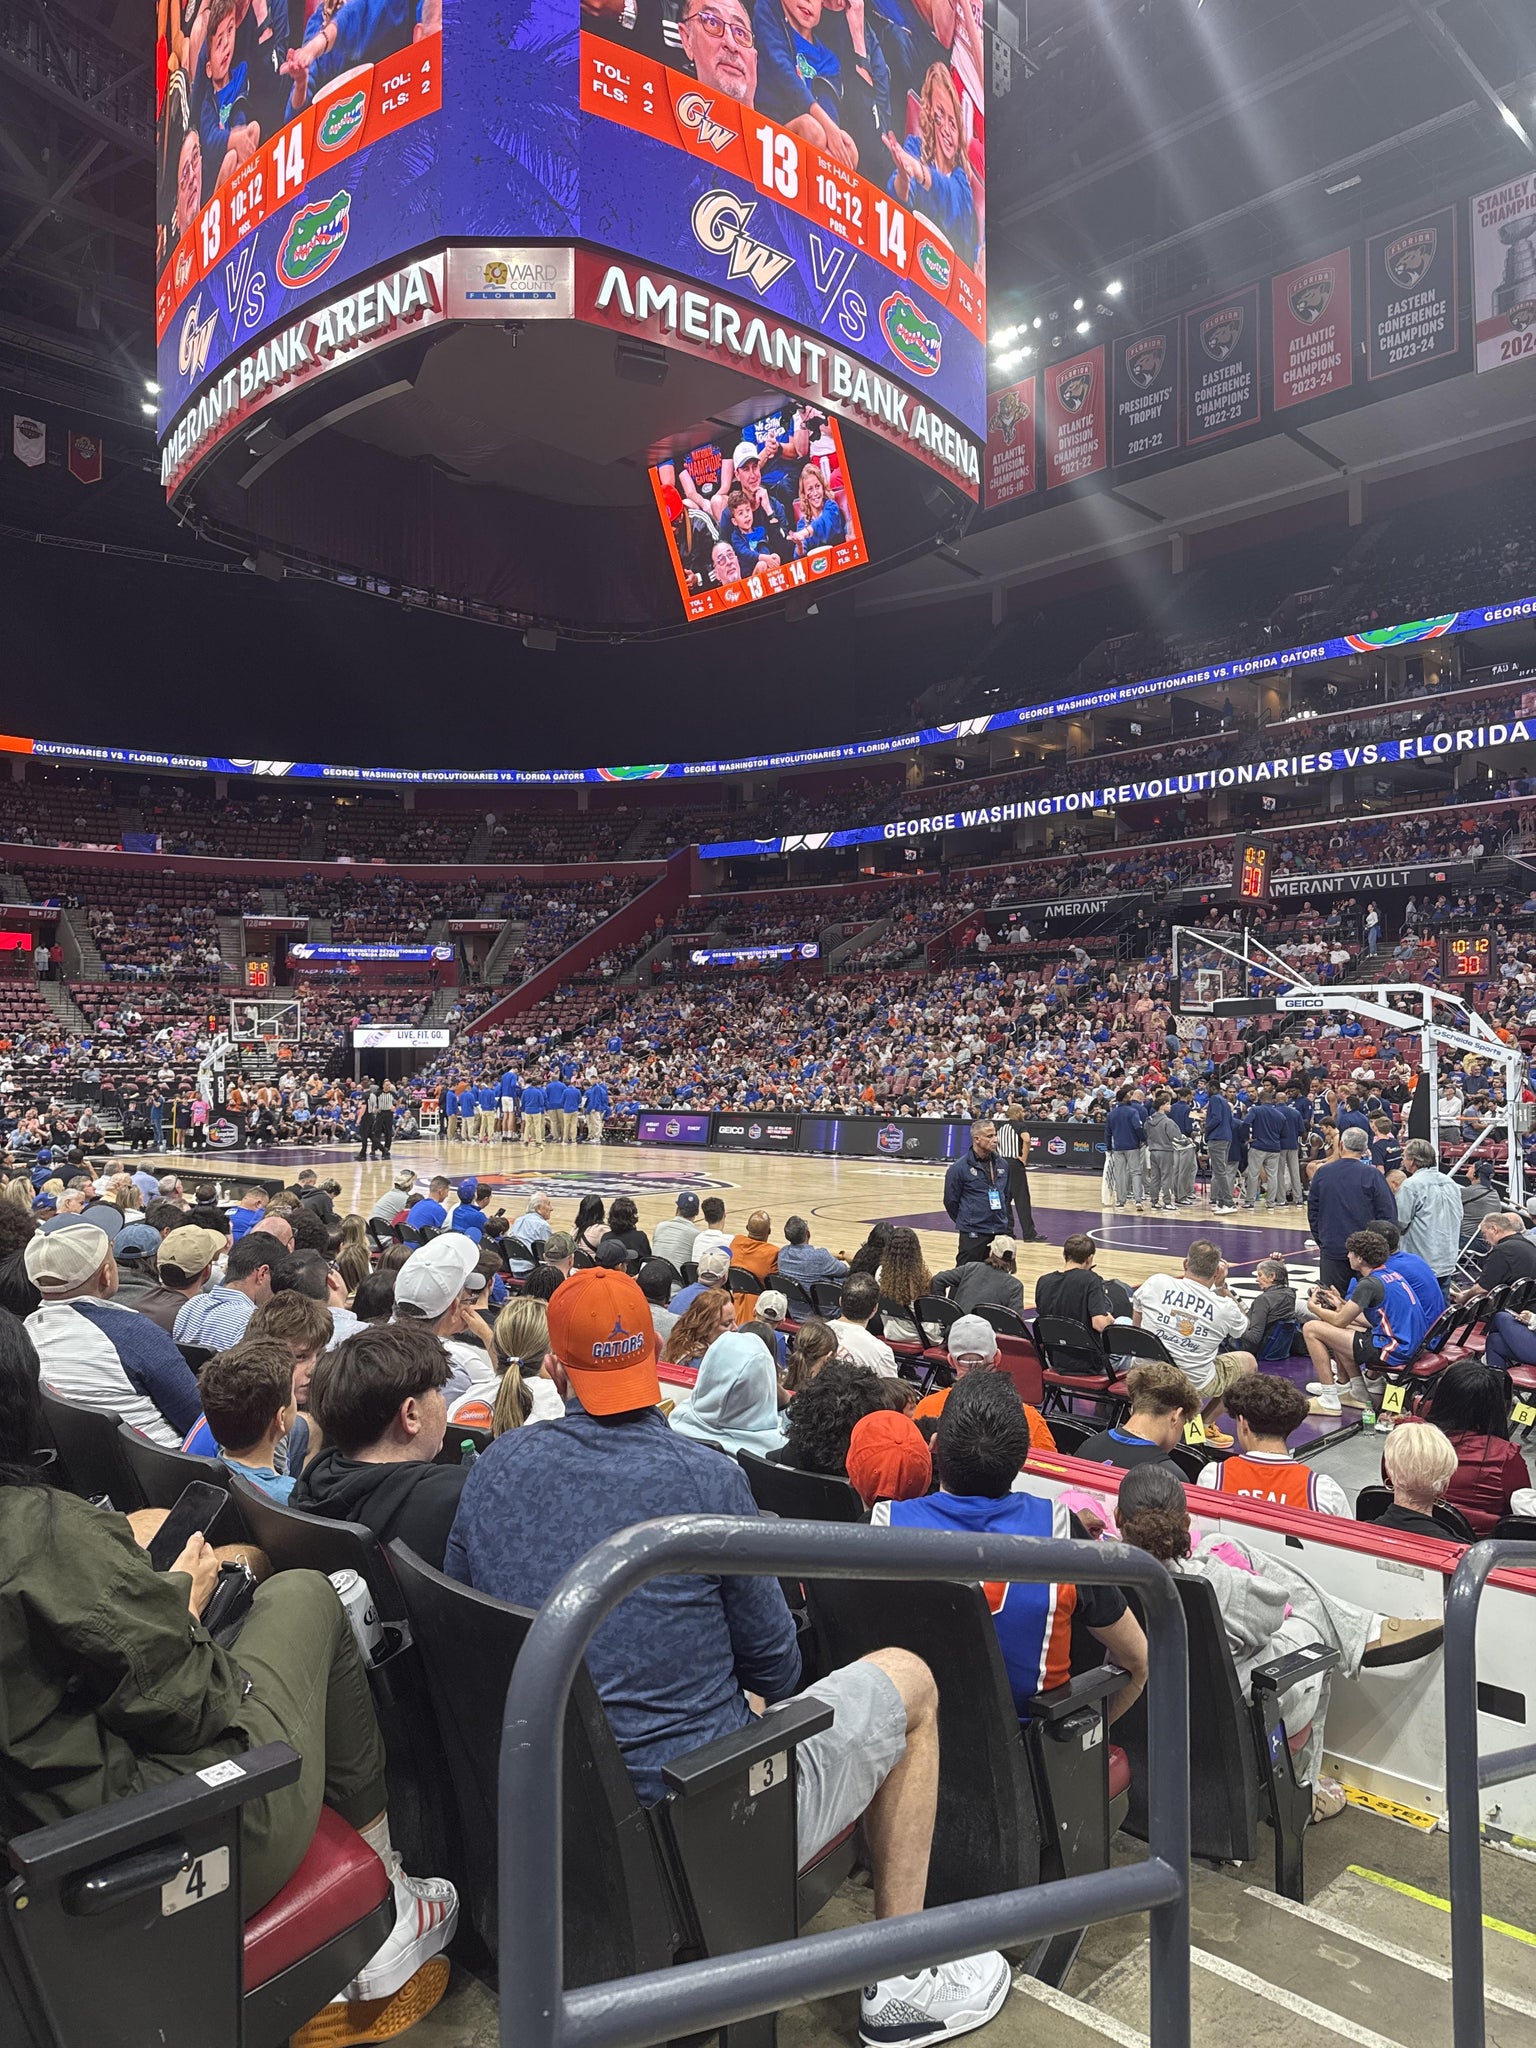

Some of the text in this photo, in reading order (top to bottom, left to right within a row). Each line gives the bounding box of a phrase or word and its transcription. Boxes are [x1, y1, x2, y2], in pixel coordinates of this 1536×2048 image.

[382, 60, 431, 94] TOL: 4
[593, 59, 654, 95] TOL: 4
[382, 80, 431, 114] FLS: 2
[593, 79, 654, 114] FLS: 2
[272, 122, 304, 200] 14
[756, 125, 799, 199] 13
[817, 155, 860, 189] 1st HALF
[230, 173, 263, 226] 10:12
[816, 174, 863, 229] 10:12
[1477, 180, 1529, 215] STANLEY
[200, 199, 221, 269] 13
[875, 199, 907, 270] 14
[1391, 233, 1431, 255] FLORIDA
[510, 281, 556, 290] COUNTY
[1293, 272, 1329, 292] FLORIDA
[1387, 288, 1436, 318] EASTERN
[1205, 311, 1238, 329] FLORIDA
[1377, 300, 1447, 337] CONFERENCE
[1288, 324, 1336, 354] ATLANTIC
[1379, 316, 1445, 352] CHAMPIONS
[1501, 331, 1536, 362] 202
[1289, 340, 1335, 368] DIVISION
[1389, 335, 1435, 364] 2023-24
[161, 265, 429, 486] AMERANT BANK ARENA
[596, 265, 981, 485] AMERANT BANK ARENA
[1202, 361, 1243, 387] EASTERN
[1282, 352, 1342, 385] CHAMPIONS
[1194, 372, 1252, 403] CONFERENCE
[1291, 370, 1334, 397] 2023-24
[1119, 386, 1173, 416] PRESIDENTS'
[1196, 387, 1250, 417] CHAMPIONS
[1058, 413, 1094, 438] ATLANTIC
[1128, 404, 1163, 427] TROPHY
[1203, 404, 1242, 428] 2022-23
[1053, 438, 1099, 466] CHAMPIONS
[1058, 428, 1093, 451] DIVISION
[1128, 432, 1163, 455] 2021-22
[992, 444, 1026, 466] ATLANTIC
[993, 455, 1025, 477] DIVISION
[1060, 454, 1092, 477] 2021-22
[989, 465, 1030, 491] CHAMPIONS
[997, 480, 1025, 500] 2015-16
[789, 560, 807, 585] 14
[746, 576, 764, 600] 13
[1019, 646, 1326, 721] GEORGE WASHINGTON REVOLUTIONARIES VS. FLORIDA GATORS
[110, 751, 126, 761] VS.
[128, 753, 169, 765] FLORIDA
[171, 757, 208, 769] GATORS
[683, 735, 921, 774] GEORGE WASHINGTON REVOLUTIONARIES VS. FLORIDA GATORS
[323, 768, 585, 781] GEORGE WASHINGTON REVOLUTIONARIES VS. FLORIDA GATORS
[884, 720, 1530, 840] GEORGE WASHINGTON REVOLUTIONARIES VS. FLORIDA
[1242, 865, 1263, 898] 30
[1350, 871, 1411, 890] VAULT
[43, 911, 58, 919] 128
[1044, 900, 1109, 918] AMERANT
[291, 920, 306, 929] 129
[451, 923, 464, 931] 129
[1452, 938, 1489, 954] 10:12
[1458, 955, 1481, 975] 30
[250, 971, 267, 987] 30
[1285, 999, 1324, 1008] GEICO
[397, 1030, 444, 1039] LIVE. FIT. GO.
[1474, 1043, 1502, 1056] Sports
[719, 1126, 745, 1135] GEICO
[1157, 1312, 1171, 1325] 20
[1162, 1289, 1214, 1322] KAPPA
[592, 1331, 644, 1359] GATORS
[1180, 1337, 1201, 1353] Day
[1194, 1326, 1209, 1338] 25
[1388, 1391, 1400, 1406] A
[1519, 1410, 1528, 1423] B
[1189, 1423, 1201, 1439] A
[763, 1758, 774, 1787] 3
[1375, 1801, 1430, 1823] STEP
[185, 1859, 206, 1899] 4
